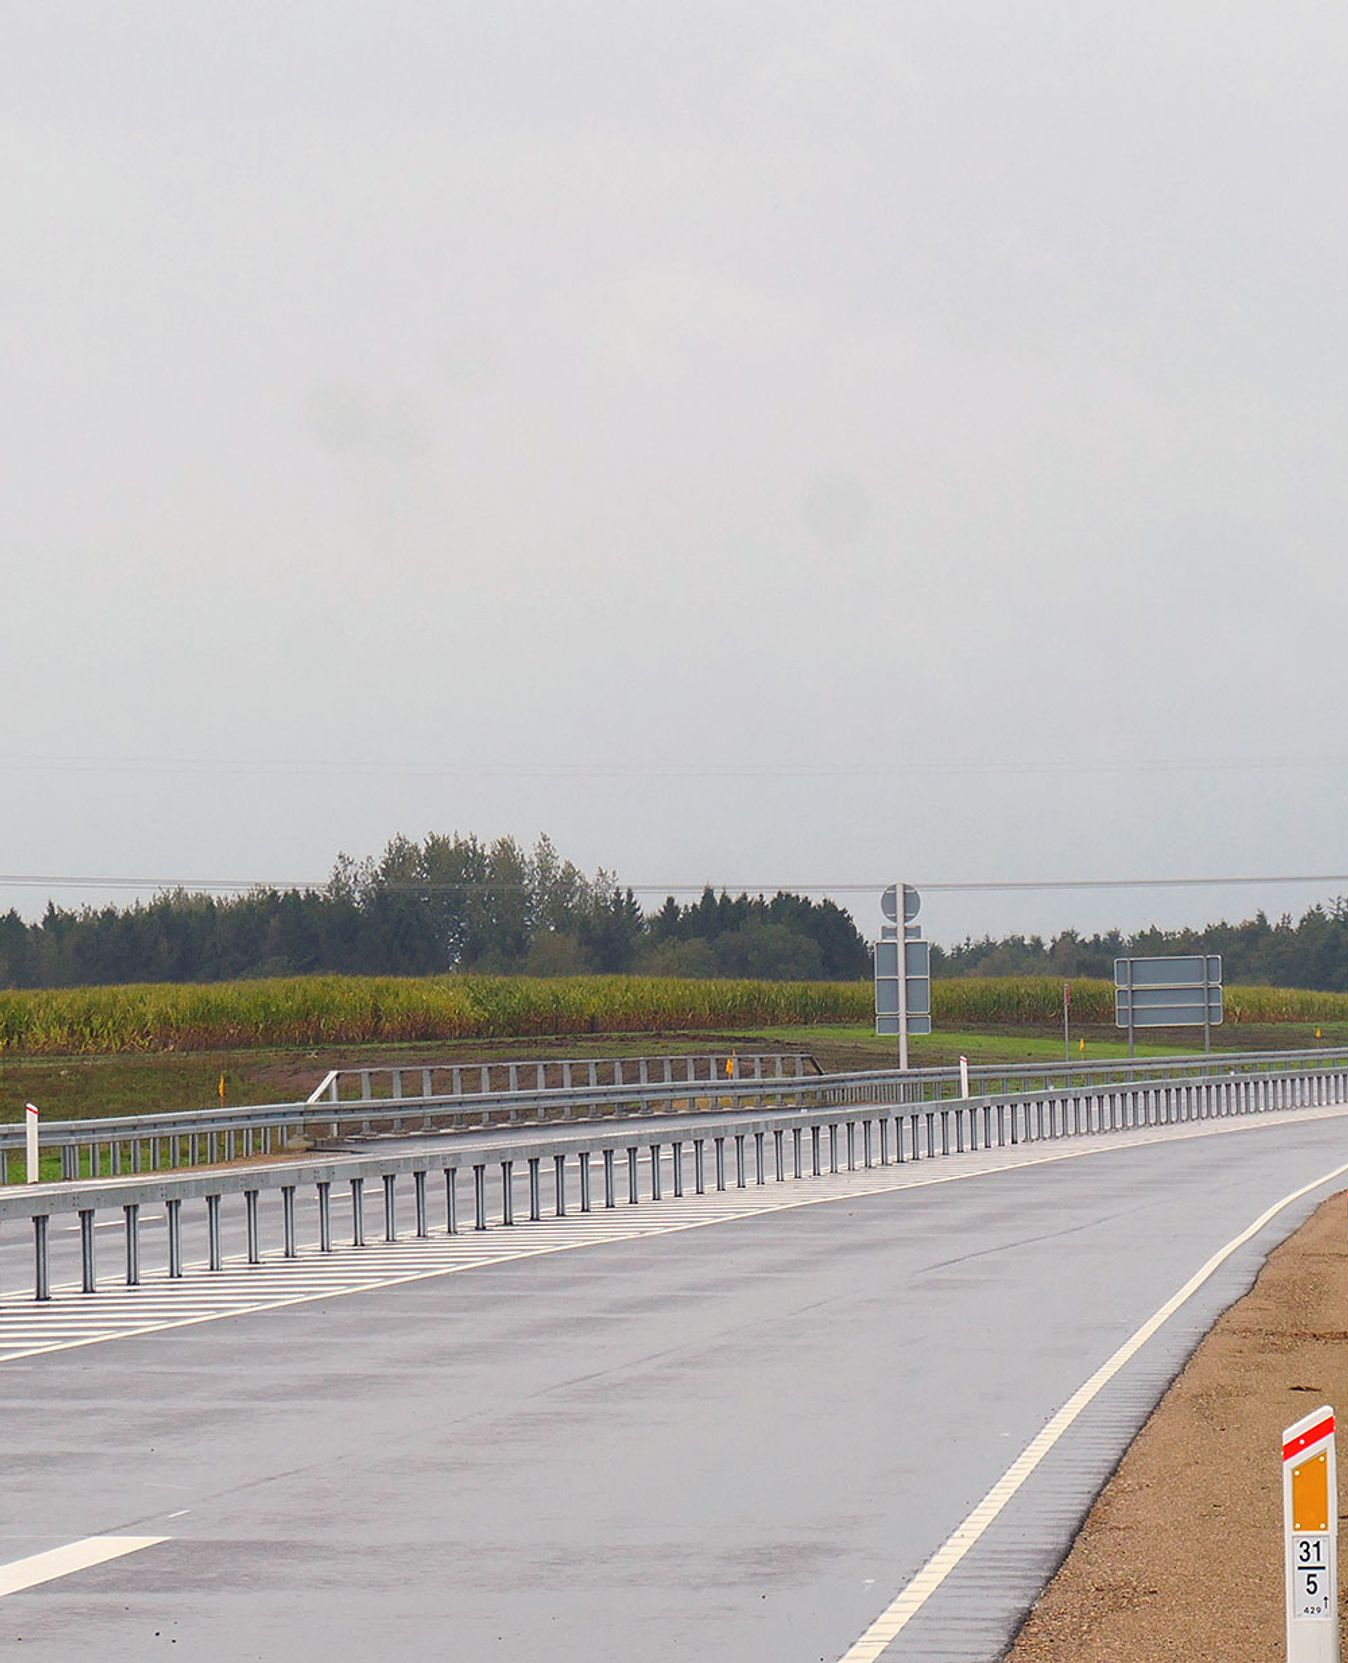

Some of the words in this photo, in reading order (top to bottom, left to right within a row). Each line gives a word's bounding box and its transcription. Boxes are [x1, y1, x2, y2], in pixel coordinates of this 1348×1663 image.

[1299, 1540, 1321, 1562] 31
[1305, 1573, 1318, 1595] 5
[1303, 1606, 1322, 1615] 429
